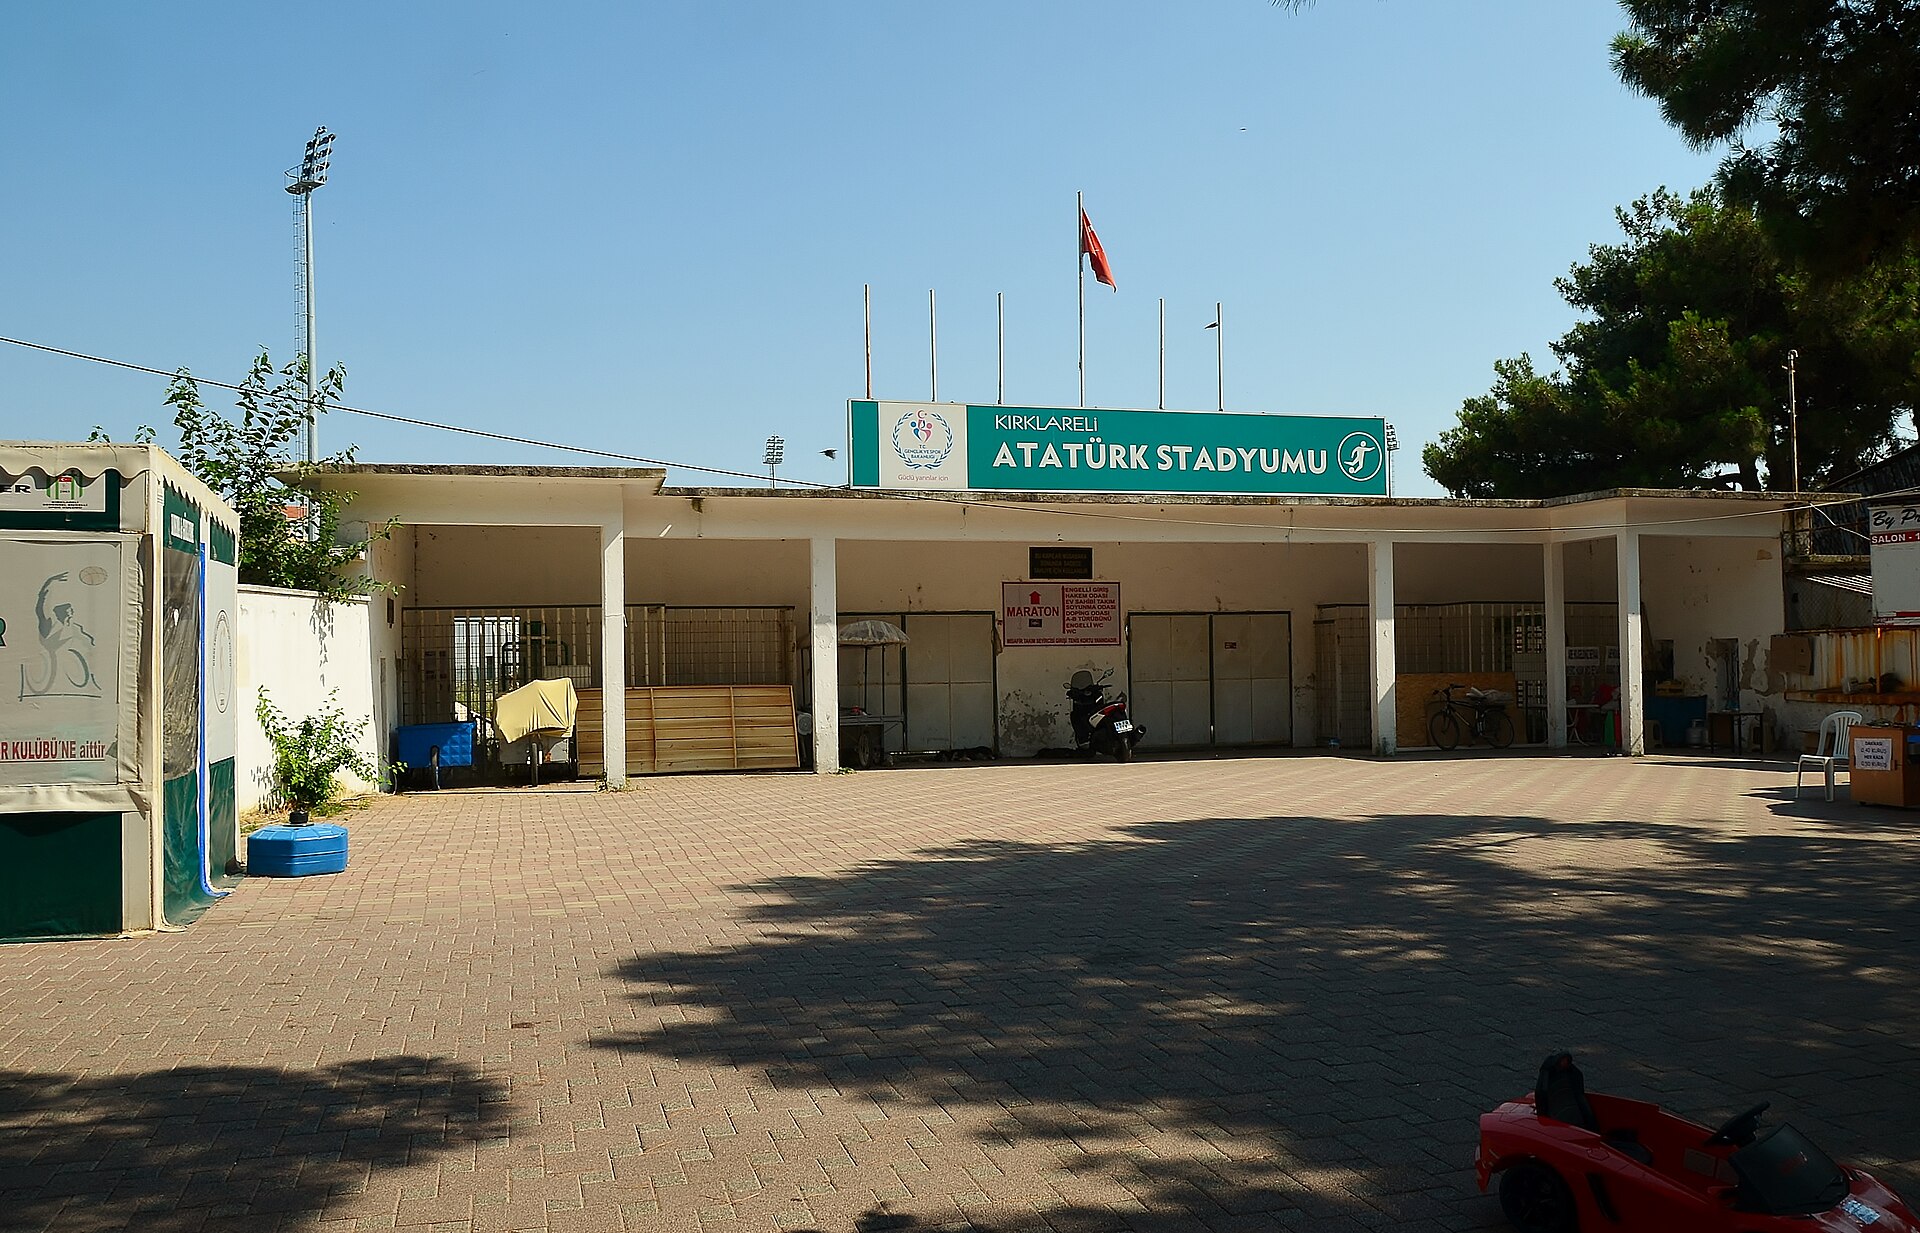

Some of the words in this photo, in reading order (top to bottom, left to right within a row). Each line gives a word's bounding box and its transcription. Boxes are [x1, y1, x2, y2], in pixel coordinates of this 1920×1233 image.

[993, 436, 1150, 469] ATATÜRK
[1156, 444, 1327, 474] STADYUMU
[1872, 510, 1895, 530] By
[1871, 533, 1906, 544] SALON
[1006, 606, 1059, 617] MARATON
[80, 740, 105, 759] aittir
